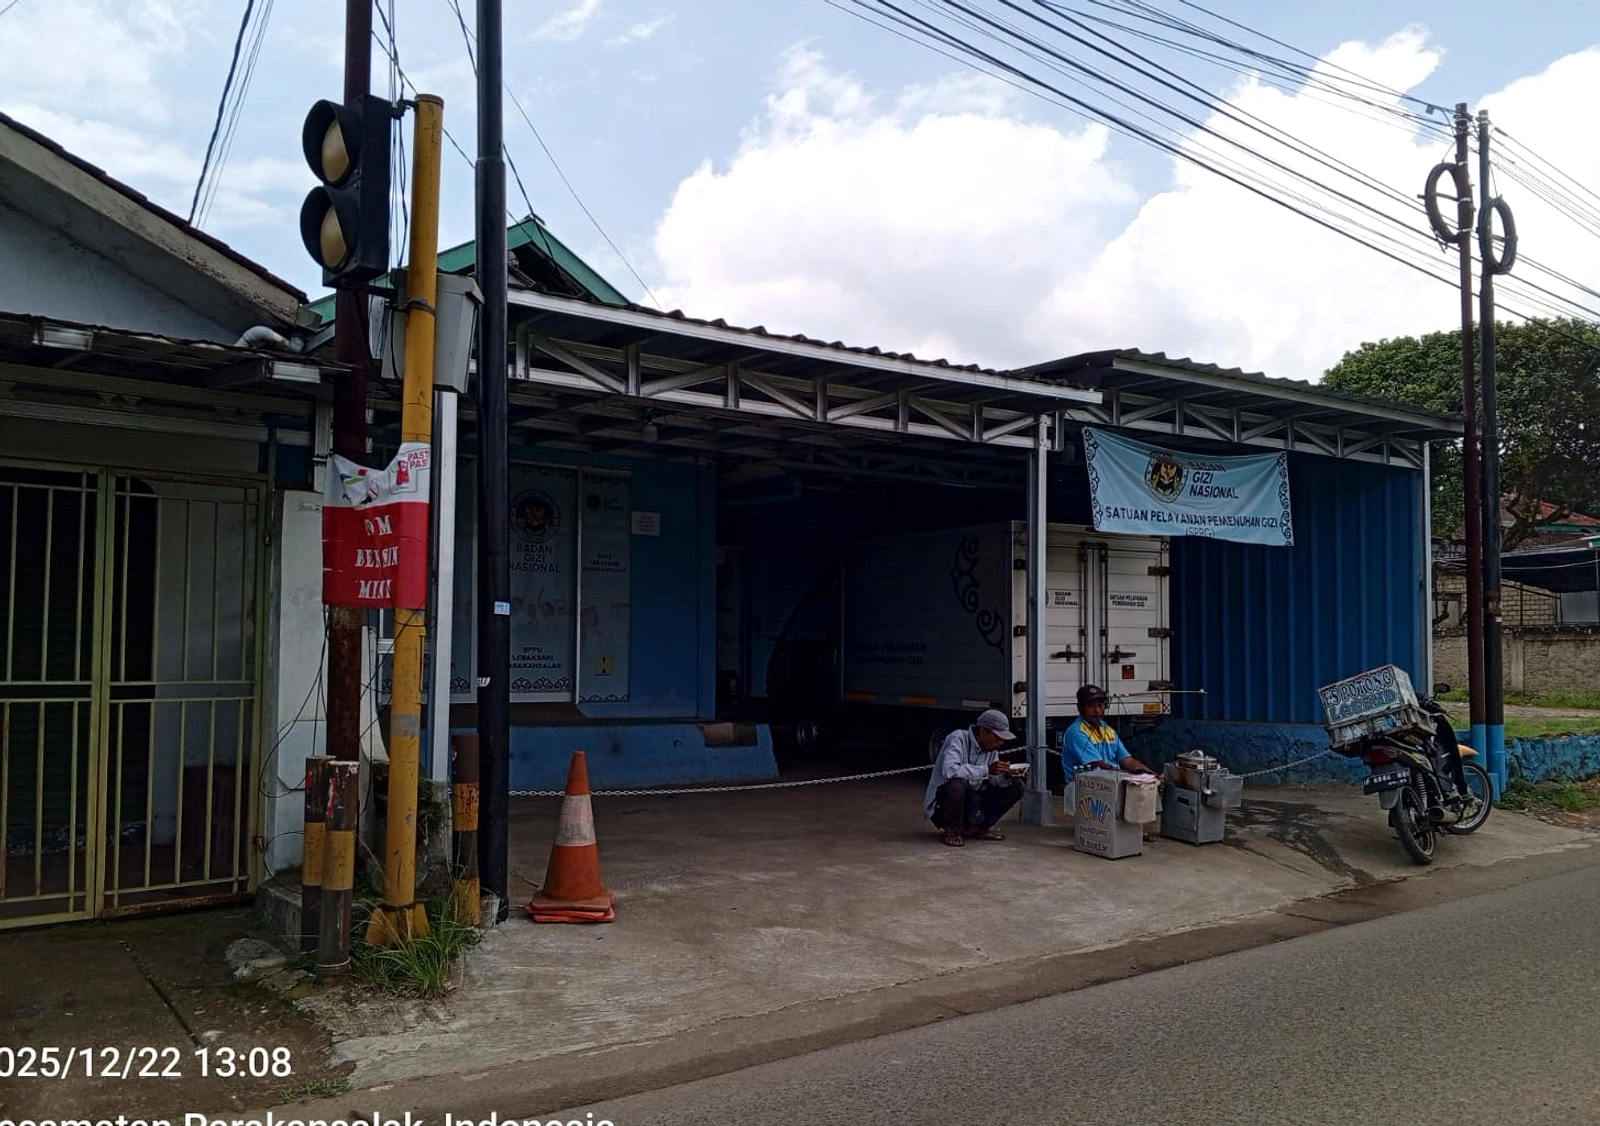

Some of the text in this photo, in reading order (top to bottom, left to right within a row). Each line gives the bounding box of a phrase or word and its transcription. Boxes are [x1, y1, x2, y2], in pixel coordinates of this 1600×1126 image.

[1193, 471, 1214, 484] GIZI
[1189, 484, 1239, 499] NASIONAL
[1105, 506, 1278, 528] SATUAN PELAYANAN PEMENUHAN GIZI
[524, 553, 545, 563] GIZI
[1340, 670, 1392, 702] POTONG
